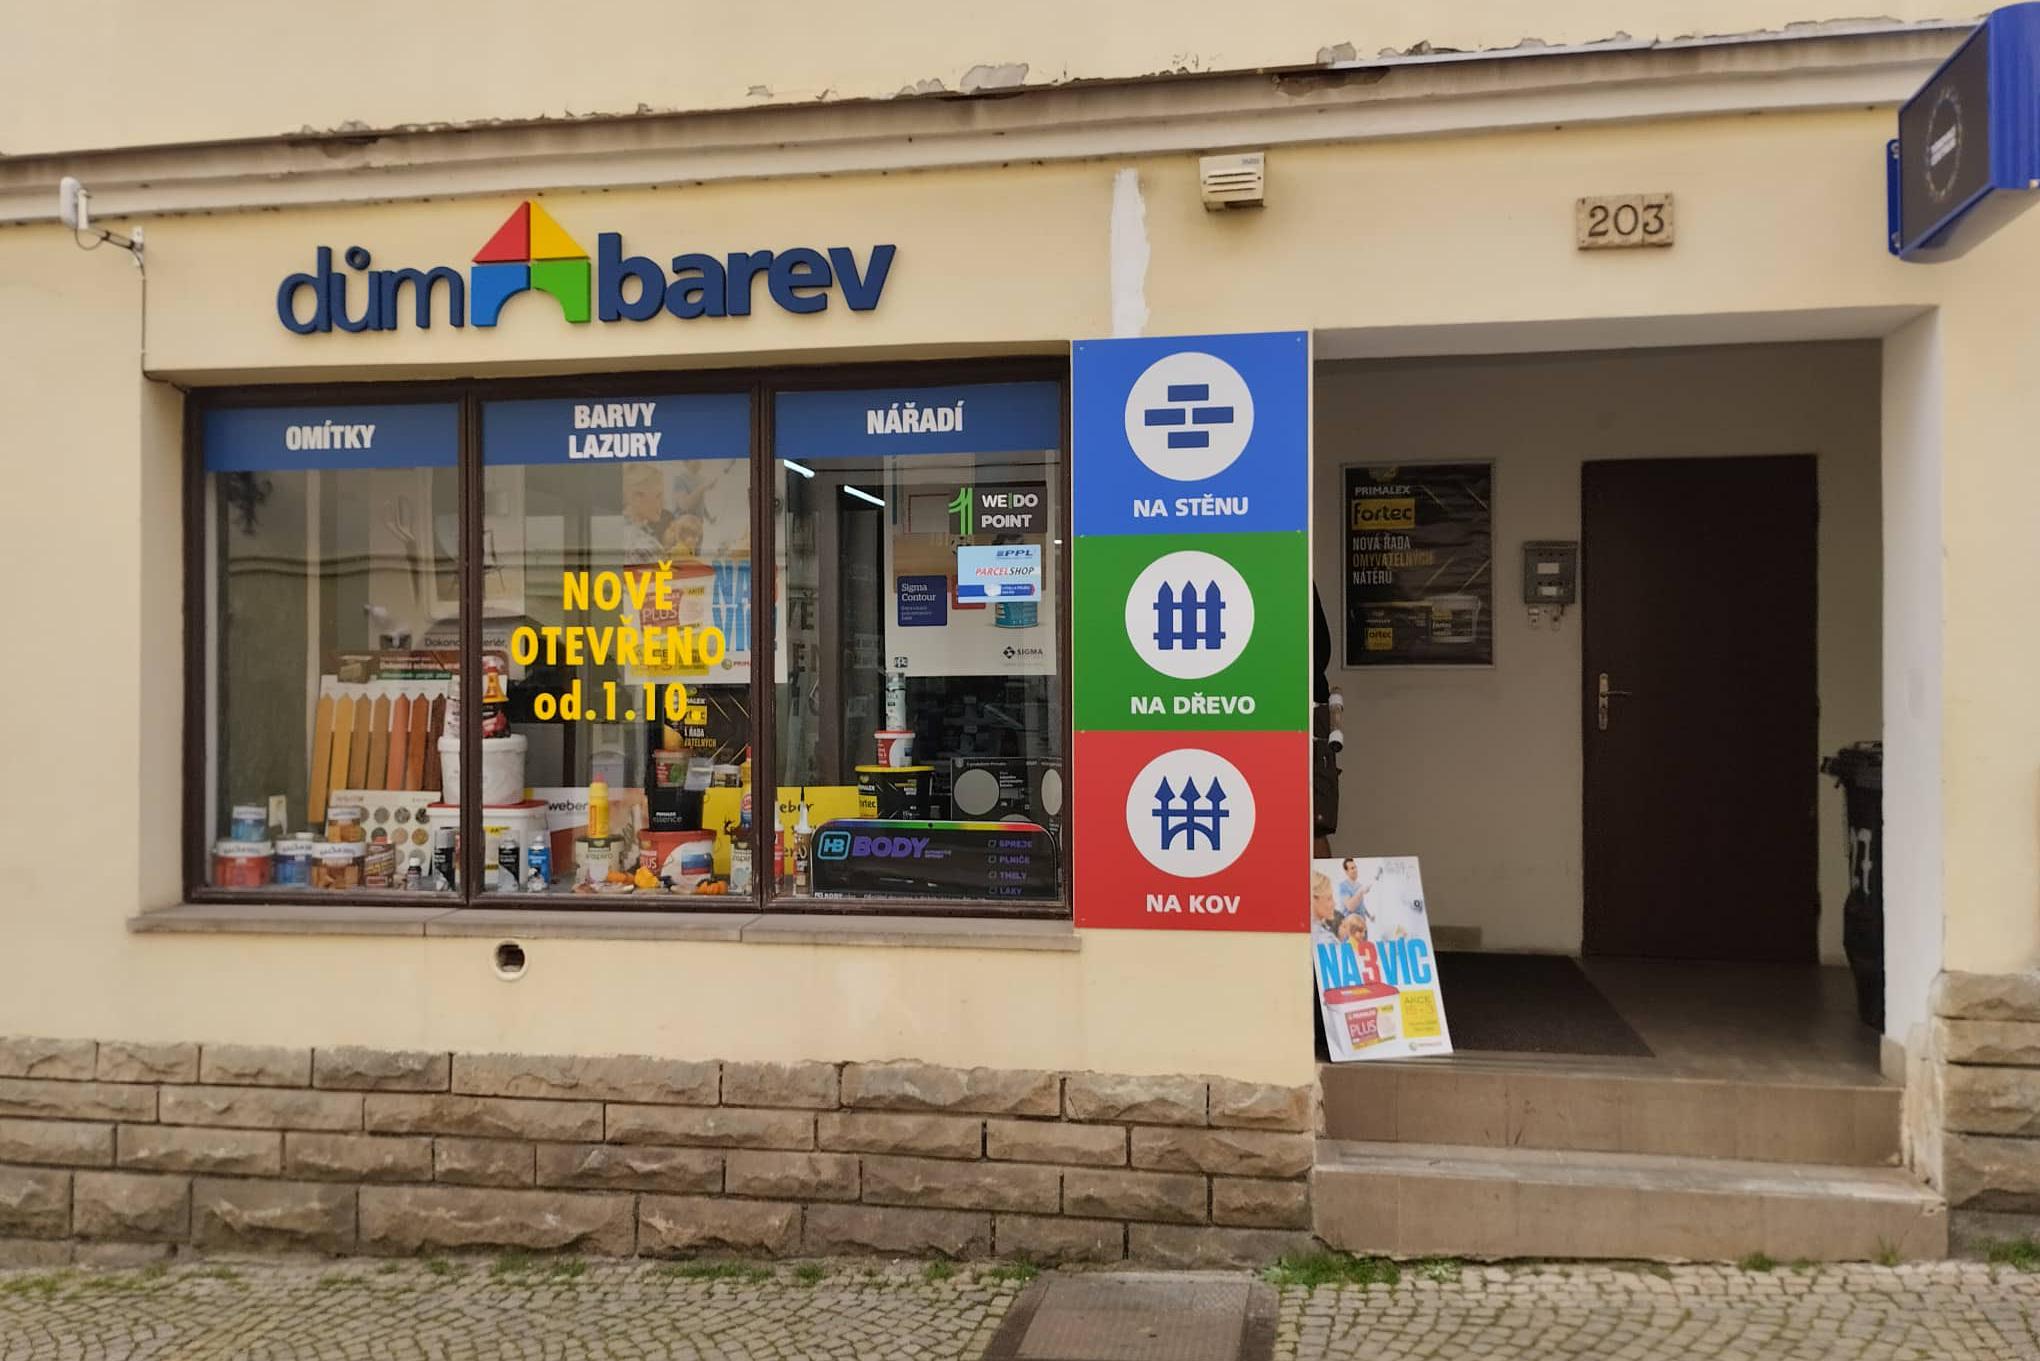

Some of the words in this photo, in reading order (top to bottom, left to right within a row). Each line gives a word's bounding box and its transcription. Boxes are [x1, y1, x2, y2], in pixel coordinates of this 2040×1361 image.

[1587, 203, 1666, 238] 203
[277, 245, 465, 335] dům
[597, 232, 897, 323] barev
[573, 402, 656, 429] BARVY
[866, 400, 965, 435] NÁŘADÍ
[285, 420, 375, 451] OMÍTKY
[568, 432, 662, 460] LAZURY
[1354, 485, 1411, 496] PRIMALEX
[1133, 499, 1168, 518] NA
[1175, 493, 1249, 517] STĚNU
[1354, 503, 1413, 525] fortec
[981, 514, 1033, 528] POINT
[1352, 533, 1380, 551] NOVÁ
[1384, 531, 1411, 550] ŘADA
[1005, 549, 1033, 557] PPL
[563, 560, 673, 612] NOVĚ
[901, 583, 928, 593] Sigma
[901, 593, 936, 602] Contour
[511, 614, 726, 667] OTEVŘENO
[533, 678, 688, 722] od.1.10
[1131, 697, 1166, 715] NA
[1173, 692, 1256, 715] DŘEVO
[548, 801, 588, 811] weber
[823, 839, 845, 853] HB
[852, 836, 929, 858] BODY
[1146, 894, 1182, 913] NA
[1190, 895, 1240, 914] KOV
[1350, 1019, 1377, 1038] PLUS
